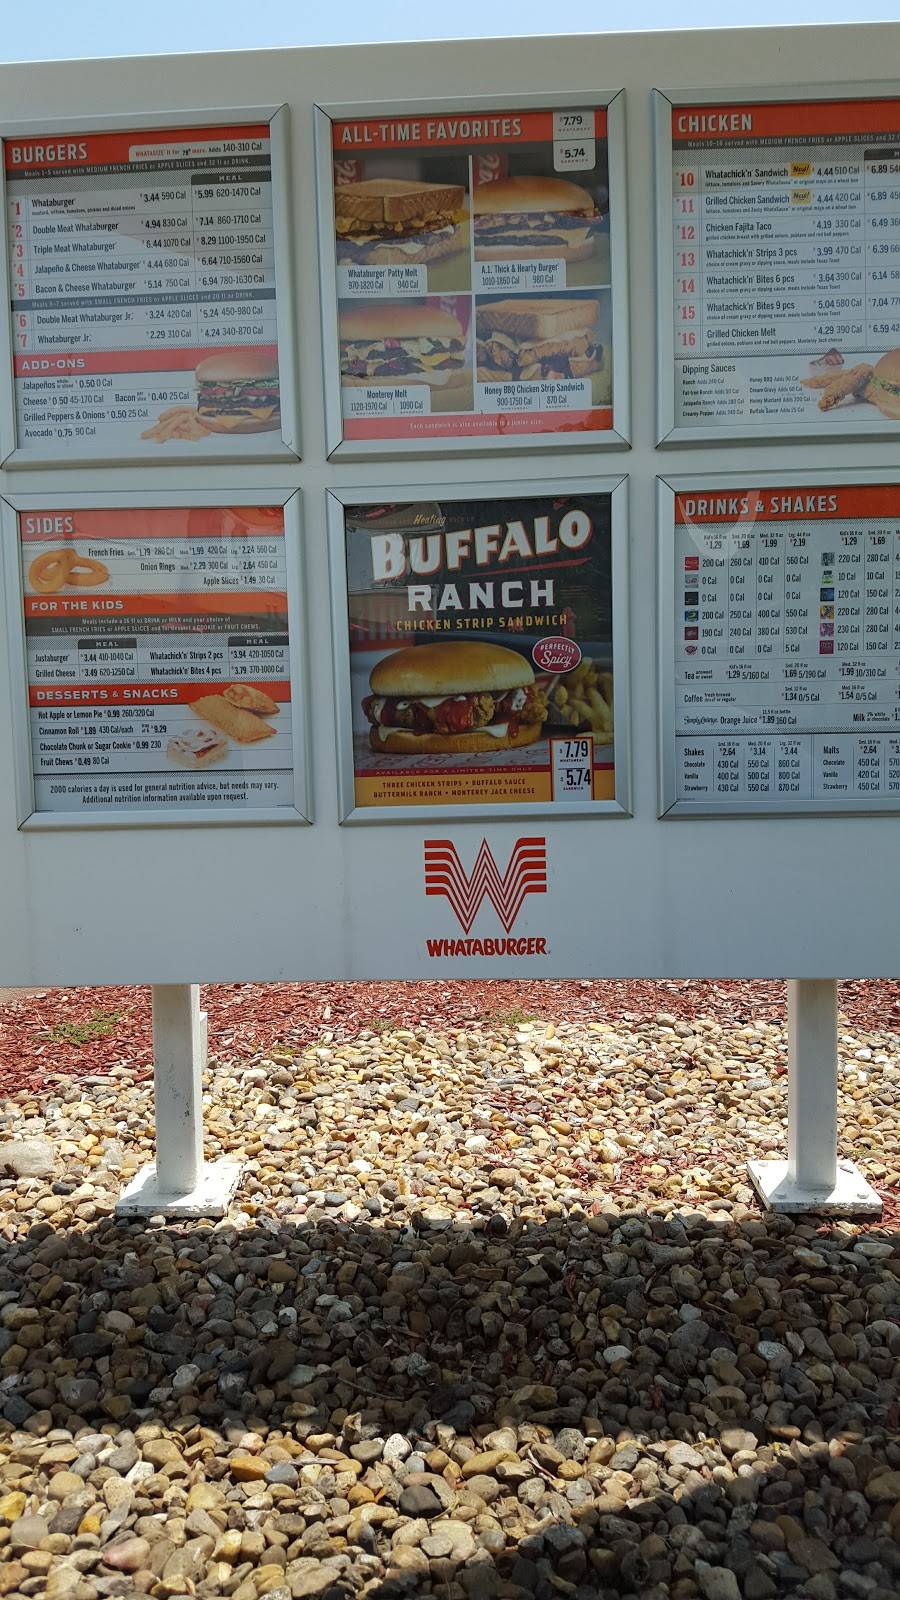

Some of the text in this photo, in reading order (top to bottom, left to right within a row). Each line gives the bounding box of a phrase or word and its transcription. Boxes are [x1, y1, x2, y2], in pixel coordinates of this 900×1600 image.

[678, 114, 752, 132] CHICKEN
[341, 118, 523, 144] ALL-TIME FAVORITES
[12, 143, 88, 163] BURGERS
[755, 168, 789, 177] Sandwich
[31, 198, 75, 208] Whataburger
[705, 195, 790, 206] Grilled Chicken Sandwich
[33, 222, 119, 234] Double Meat Whataburger
[706, 223, 734, 235] Chicken
[756, 221, 772, 231] Taco
[33, 243, 116, 255] Triple Meat Whataburger
[756, 248, 777, 259] Strips
[784, 248, 798, 258] pcs
[71, 263, 96, 272] Cheese
[96, 261, 140, 271] Whataburger
[756, 275, 774, 284] Bites
[782, 275, 795, 285] pcs
[35, 281, 136, 294] Bacon Cheese Whataburger
[756, 301, 774, 311] Bites
[782, 301, 796, 312] pcs
[36, 311, 123, 325] Double Meat Whataburger
[706, 327, 776, 338] Grilled Chicken Melt
[38, 334, 81, 344] Whataburger
[22, 359, 86, 371] ADD-ONS
[682, 363, 736, 376] Dipping Sauces
[484, 386, 502, 396] Honey
[516, 384, 541, 396] Chicken
[541, 384, 556, 395] Strip
[556, 382, 585, 393] Sandwich
[23, 396, 48, 405] Cheese
[115, 393, 136, 403] Bacon
[24, 410, 106, 423] Grilled Peppers Onions
[24, 428, 53, 438] Avocado
[685, 495, 837, 516] DRINKS & SHAKES
[26, 516, 74, 534] SIDES
[370, 509, 594, 581] BUFFALO
[88, 547, 125, 557] French Fries
[407, 578, 555, 612] RANCH
[31, 600, 124, 611] FOR THE KIDS
[396, 614, 568, 632] CHICKEN STRIP SANDWICH
[540, 643, 576, 654] PERFECTLY
[540, 650, 572, 668] Spicy
[35, 669, 76, 678] Grilled Cheese
[685, 671, 695, 680] Tea
[36, 689, 178, 700] DESSERTS SNACKS
[684, 694, 703, 703] Coffee
[49, 711, 65, 720] Apple
[73, 710, 92, 719] Lemon
[853, 713, 866, 722] Milk
[720, 716, 741, 726] Orange
[742, 716, 758, 725] Juice
[39, 726, 79, 735] Cinnamon Roll
[39, 740, 132, 752] Chocolate Chunk Sugar Cookie
[823, 746, 840, 754] Malts
[684, 748, 705, 757] Shakes
[40, 758, 54, 767] Fruit
[68, 783, 92, 793] calories
[98, 784, 110, 795] day
[118, 783, 133, 792] used
[134, 783, 143, 792] for
[144, 783, 167, 793] general
[168, 782, 195, 791] nutrition
[219, 781, 230, 790] but
[231, 780, 249, 790] needs
[250, 781, 262, 791] may
[382, 778, 526, 790] THREE CHICKEN STRIPS BUFFALO SAUCE
[82, 794, 112, 804] Additional
[114, 794, 142, 804] nutrition
[142, 793, 177, 803] information
[179, 792, 205, 802] available
[207, 793, 221, 803] upon
[373, 789, 417, 799] BUTTERMILK
[419, 789, 442, 797] RANCH
[452, 788, 488, 797] MONTEREY
[509, 787, 536, 795] CHEESE
[426, 937, 548, 958] WHATABURGER
